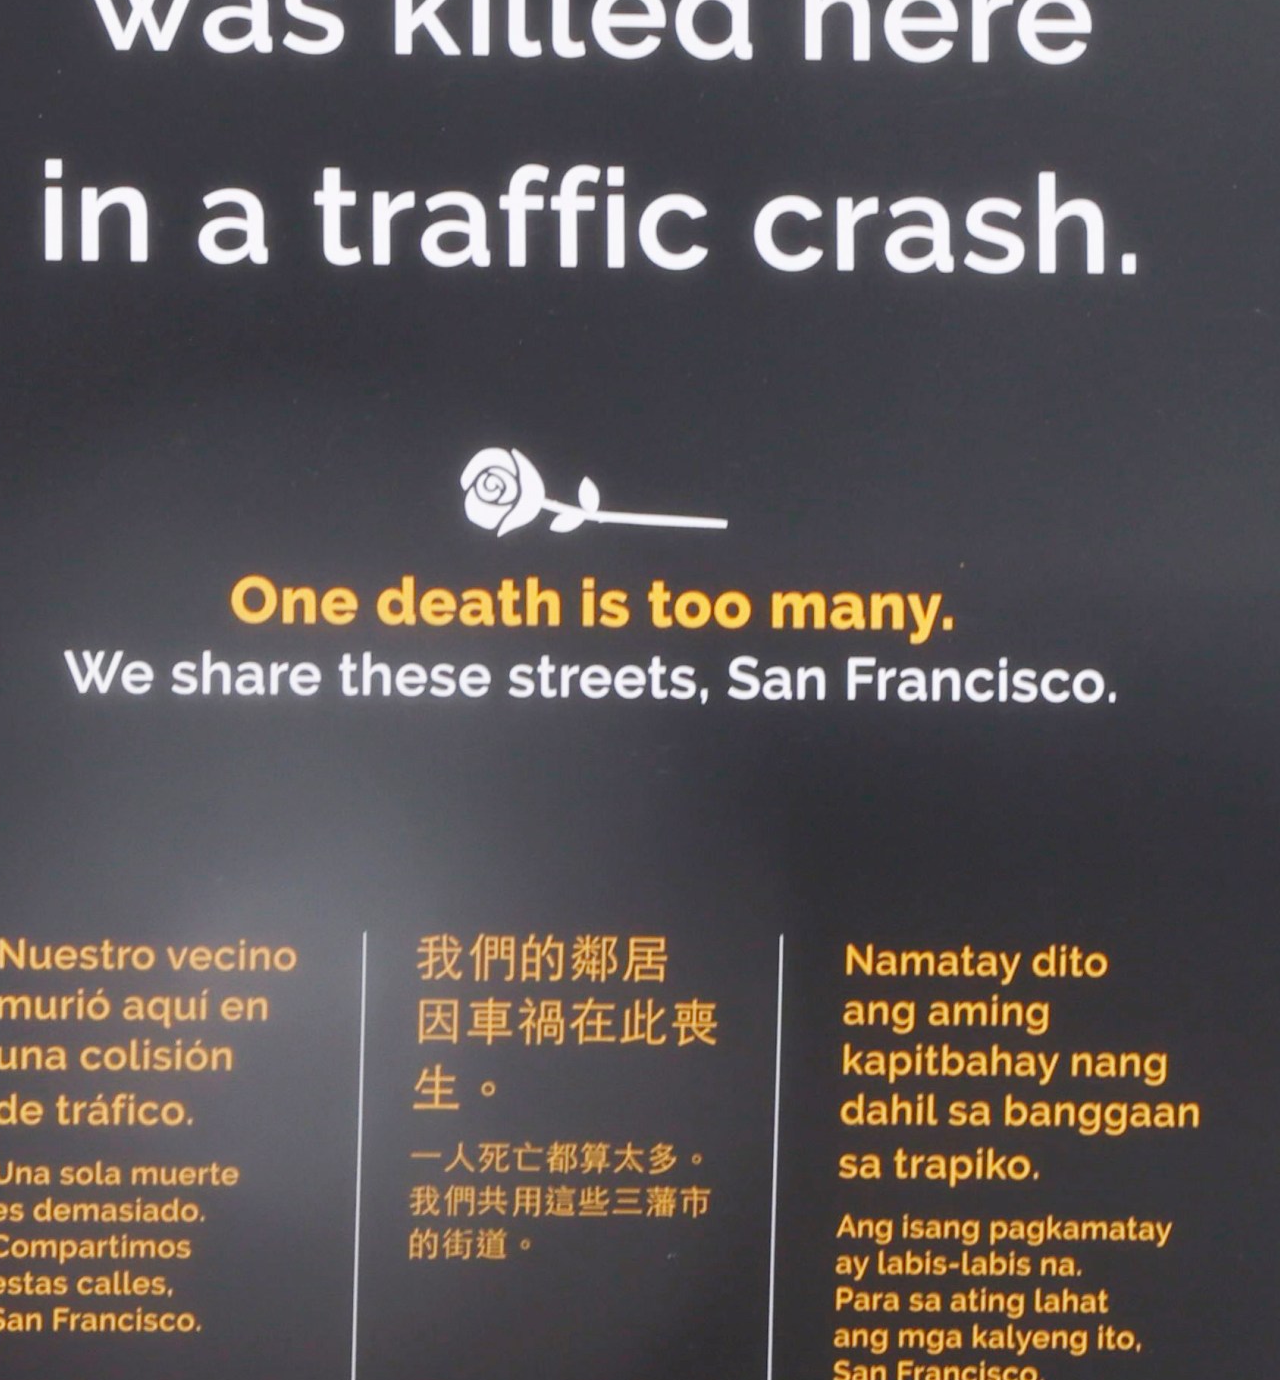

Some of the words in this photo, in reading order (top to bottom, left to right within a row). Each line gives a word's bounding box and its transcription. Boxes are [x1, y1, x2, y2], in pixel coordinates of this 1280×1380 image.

[45, 159, 148, 262] in
[198, 188, 268, 264] a
[314, 164, 708, 270] traffic
[754, 172, 1136, 274] crash.
[231, 575, 358, 625] One
[377, 576, 560, 626] death
[582, 577, 629, 627] is
[648, 580, 751, 629] too
[772, 591, 953, 644] many.
[64, 650, 154, 694] We
[172, 650, 321, 696] share
[339, 652, 491, 697] these
[509, 655, 708, 704] streets,
[728, 656, 825, 700] San
[847, 657, 1116, 703] Francisco.
[167, 939, 297, 971] vecino
[417, 934, 667, 982] 我們的鄰居
[846, 944, 1021, 985] Namatay
[1032, 945, 1108, 977] dito
[123, 989, 208, 1028] aquí
[221, 997, 268, 1021] en
[418, 997, 717, 1046] 因車禍在此喪
[843, 1001, 915, 1034] ang
[928, 994, 1049, 1035] aming
[80, 1039, 232, 1071] colisión
[843, 1043, 1059, 1085] kapitbahay
[1072, 1053, 1167, 1086] nang
[413, 1064, 495, 1109] 生。
[56, 1093, 192, 1126] tráfico.
[841, 1093, 938, 1125] dahil
[949, 1101, 990, 1126] sa
[1005, 1094, 1199, 1135] banggaan
[60, 1161, 121, 1185] sola
[132, 1163, 239, 1185] muerte
[411, 1141, 701, 1174] 一人死亡都算太多。
[839, 1154, 881, 1178] sa
[894, 1148, 1039, 1187] trapiko.
[33, 1198, 204, 1222] demasiado.
[837, 1214, 893, 1245] Ang
[902, 1214, 980, 1245] isang
[990, 1215, 1172, 1247] pagkamatay
[77, 1271, 172, 1296] calles,
[836, 1256, 869, 1281] ay
[878, 1250, 1031, 1276] labis-labis
[1041, 1257, 1081, 1276] na.
[53, 1307, 200, 1331] Francisco.
[836, 1286, 899, 1311] Para
[910, 1293, 941, 1311] sa
[950, 1288, 1024, 1319] ating
[1035, 1288, 1108, 1313] lahat
[834, 1328, 888, 1354] ang
[899, 1329, 962, 1354] mga
[973, 1324, 1087, 1356] kalyeng
[1098, 1325, 1141, 1351] ito,
